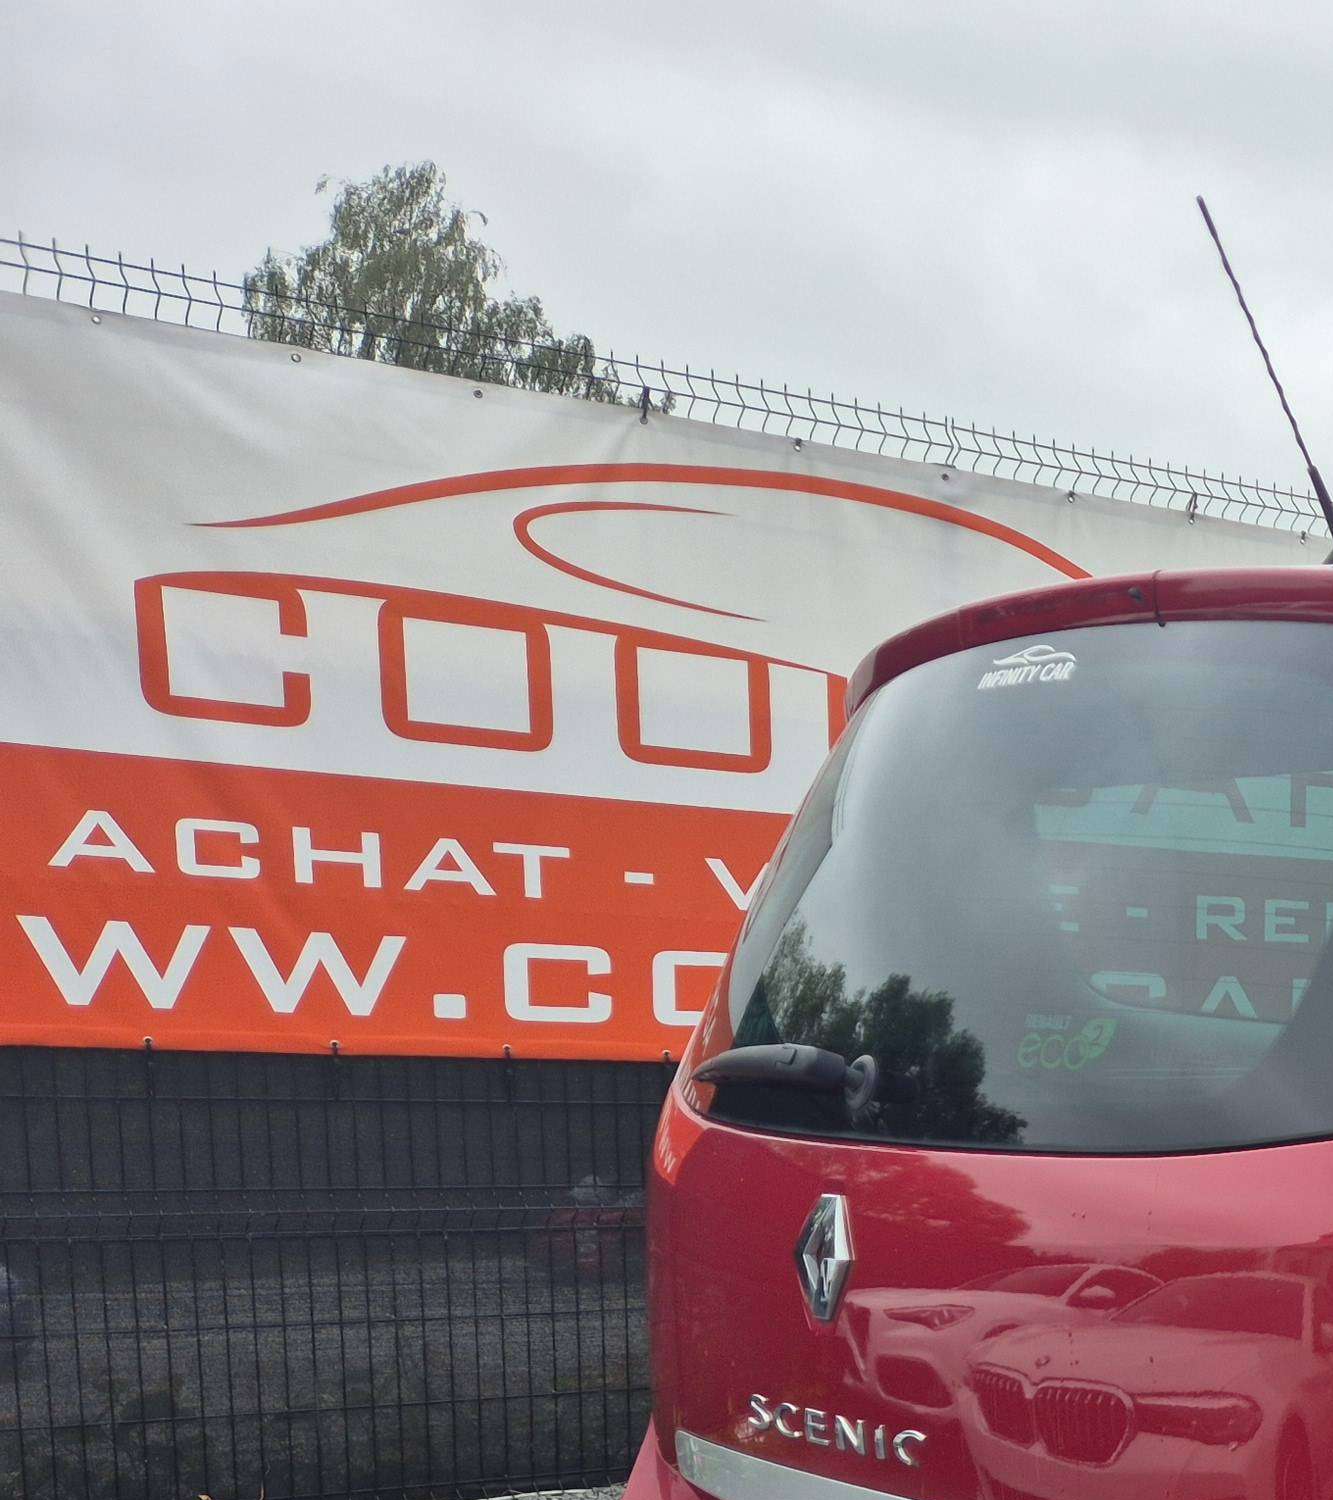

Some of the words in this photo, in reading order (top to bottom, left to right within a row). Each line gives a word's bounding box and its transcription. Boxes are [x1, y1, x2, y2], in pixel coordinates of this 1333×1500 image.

[977, 663, 1042, 690] INFINITY
[1039, 661, 1075, 682] CAR
[48, 810, 570, 899] ACHAT
[748, 1393, 928, 1467] SCENIC
